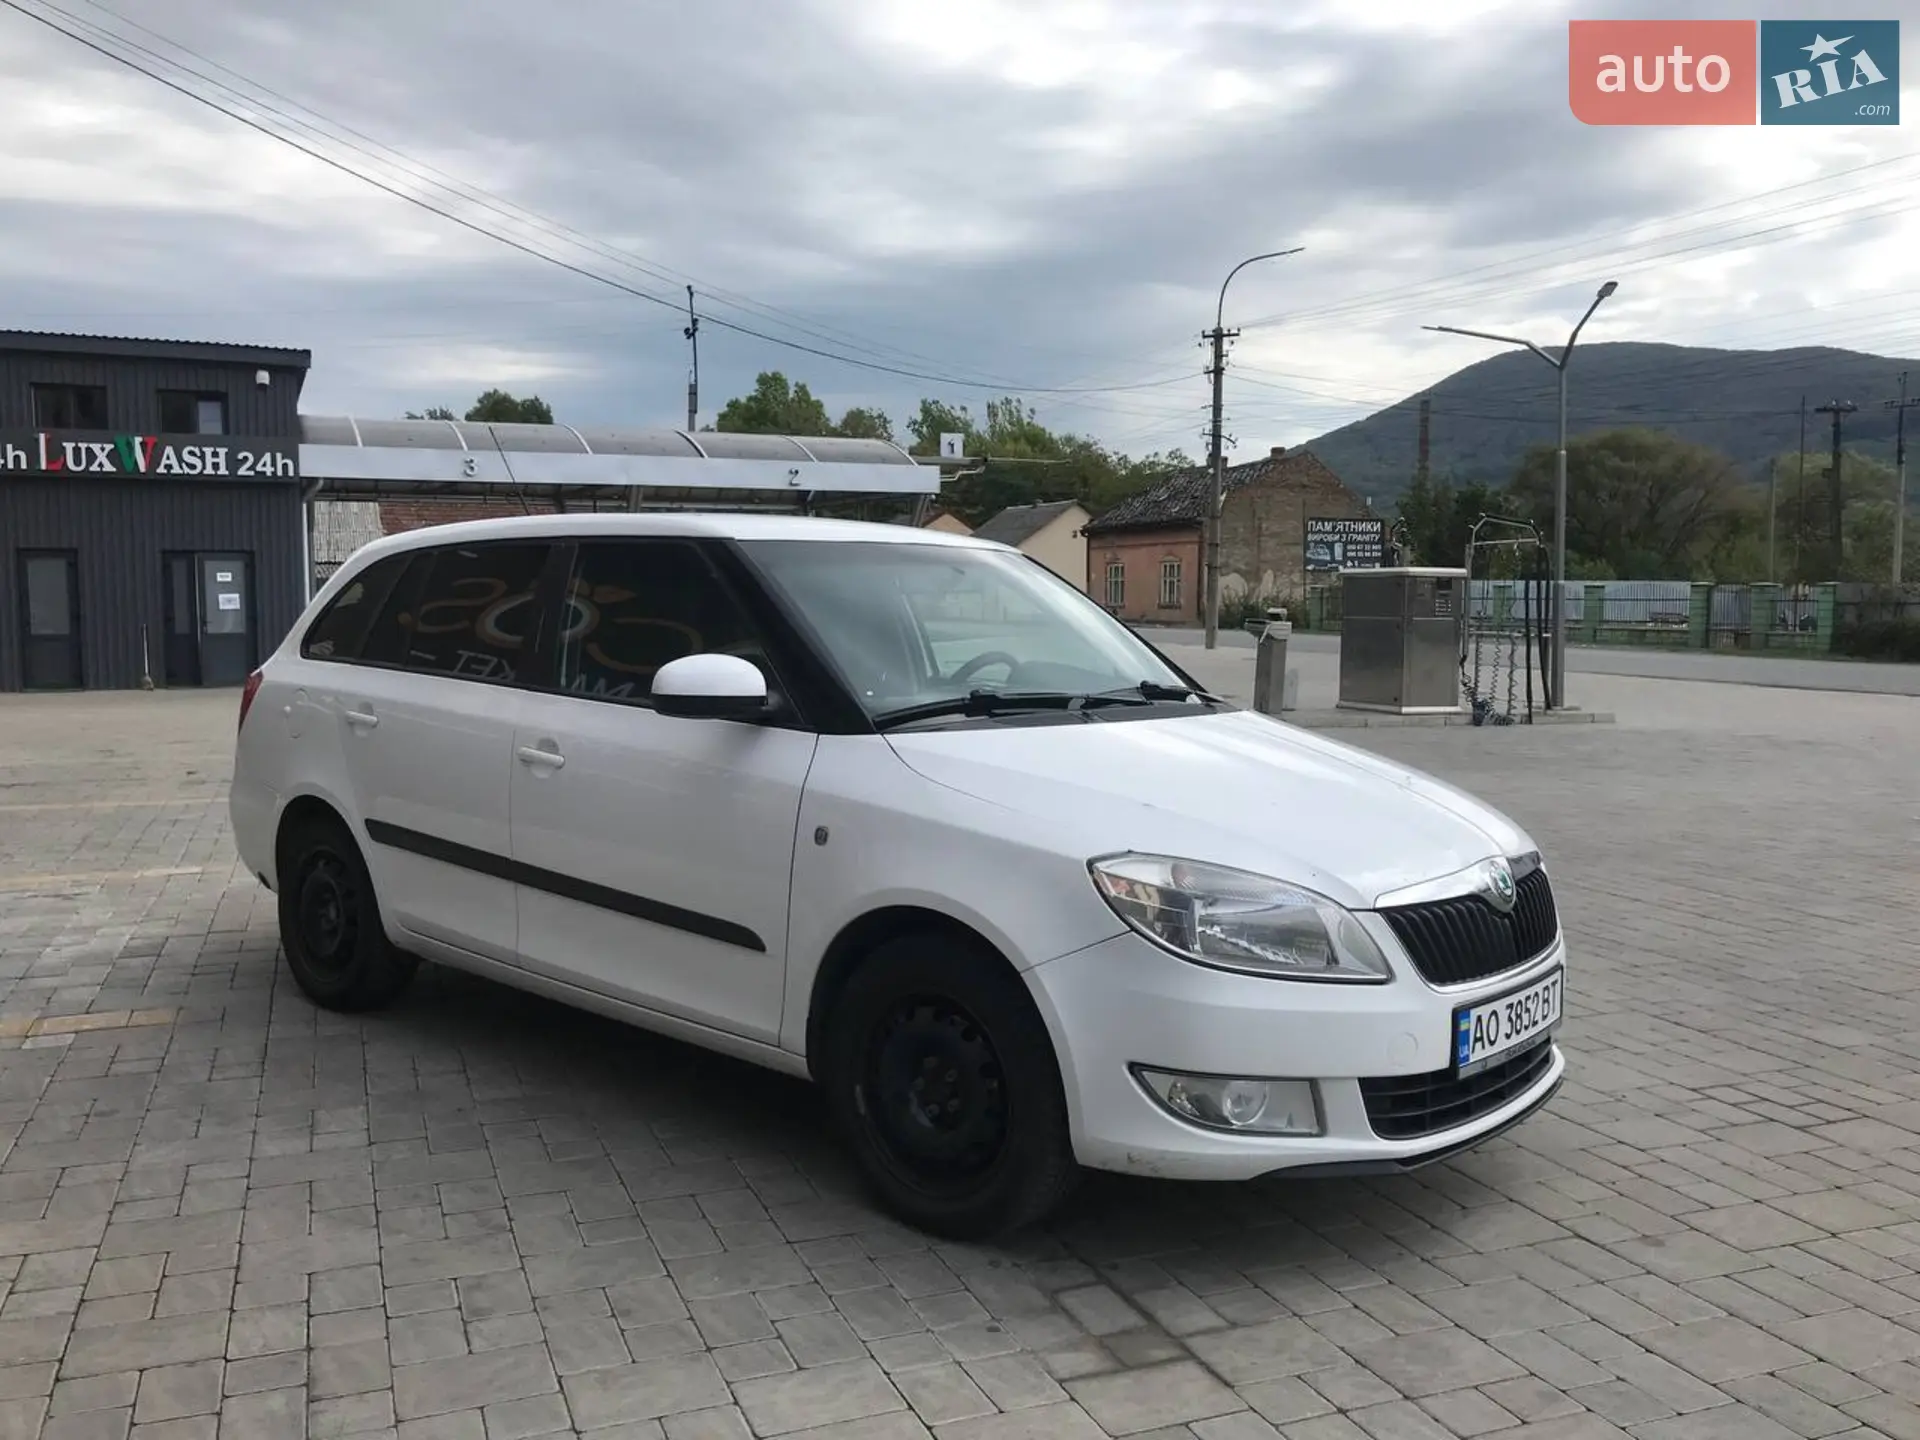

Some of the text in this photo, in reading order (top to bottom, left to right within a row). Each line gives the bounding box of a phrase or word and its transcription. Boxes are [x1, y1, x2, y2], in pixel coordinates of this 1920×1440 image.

[237, 451, 295, 477] 24h
[463, 457, 478, 478] 3
[788, 468, 801, 487] 2
[1307, 521, 1381, 532] ПАМ'ЯТНИКИ
[1471, 1009, 1499, 1054] AO
[1504, 991, 1539, 1040] 3852
[1541, 979, 1559, 1021] BT
